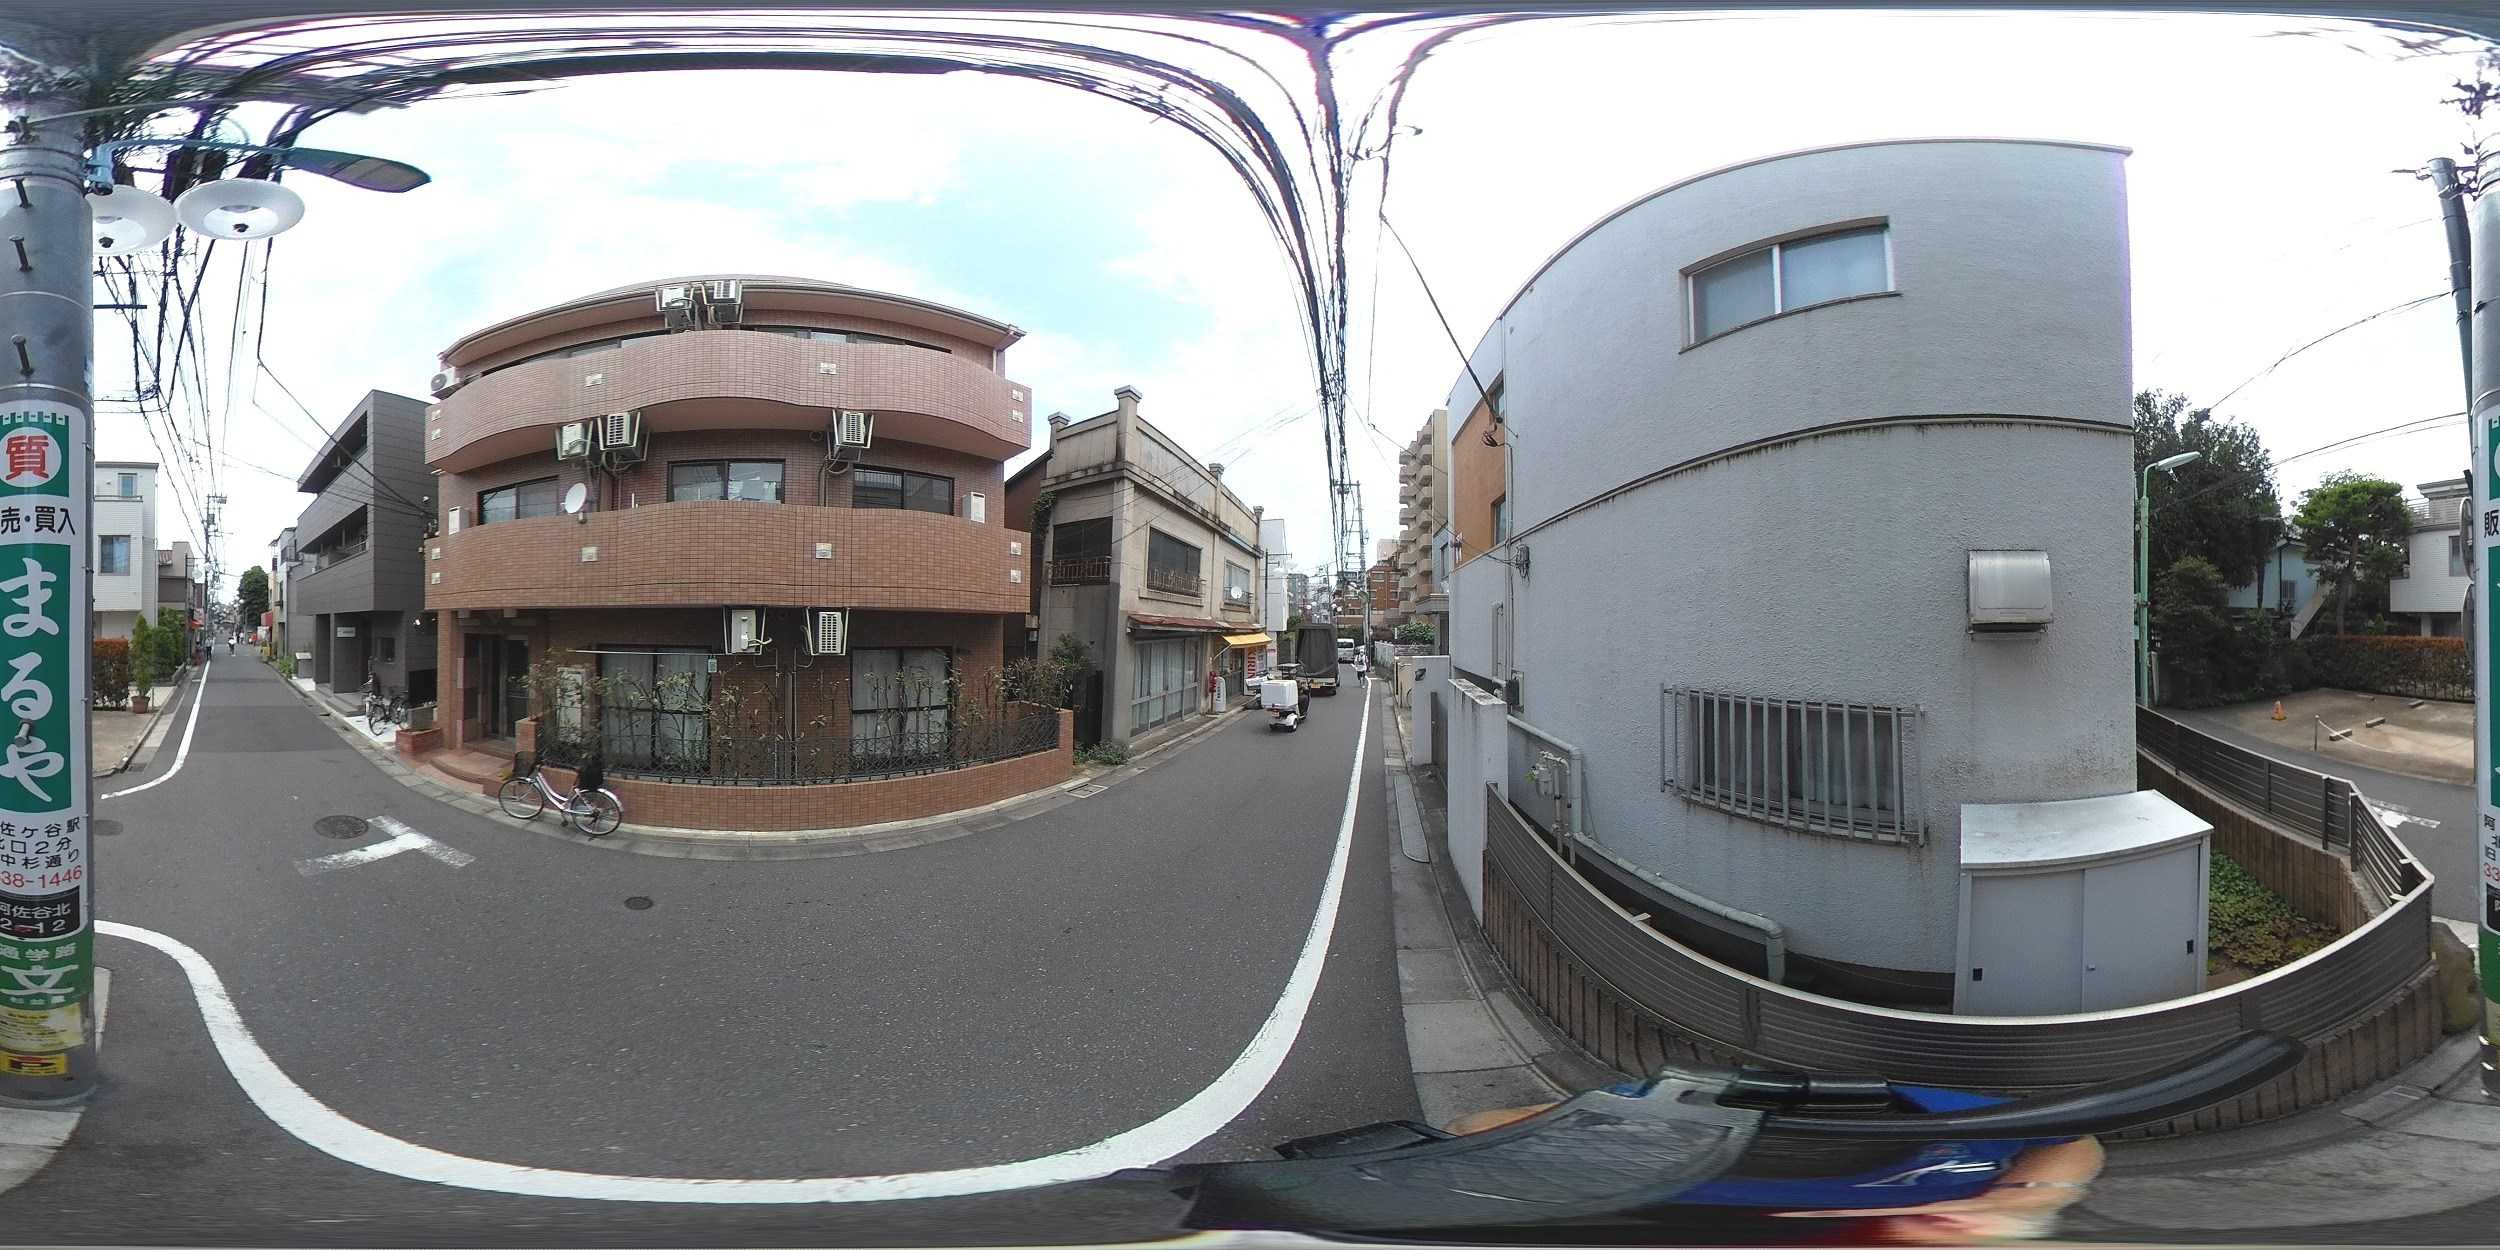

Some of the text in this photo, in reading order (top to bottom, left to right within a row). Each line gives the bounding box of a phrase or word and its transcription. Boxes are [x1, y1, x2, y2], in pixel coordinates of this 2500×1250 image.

[6, 435, 49, 481] 質
[0, 557, 65, 802] まるや
